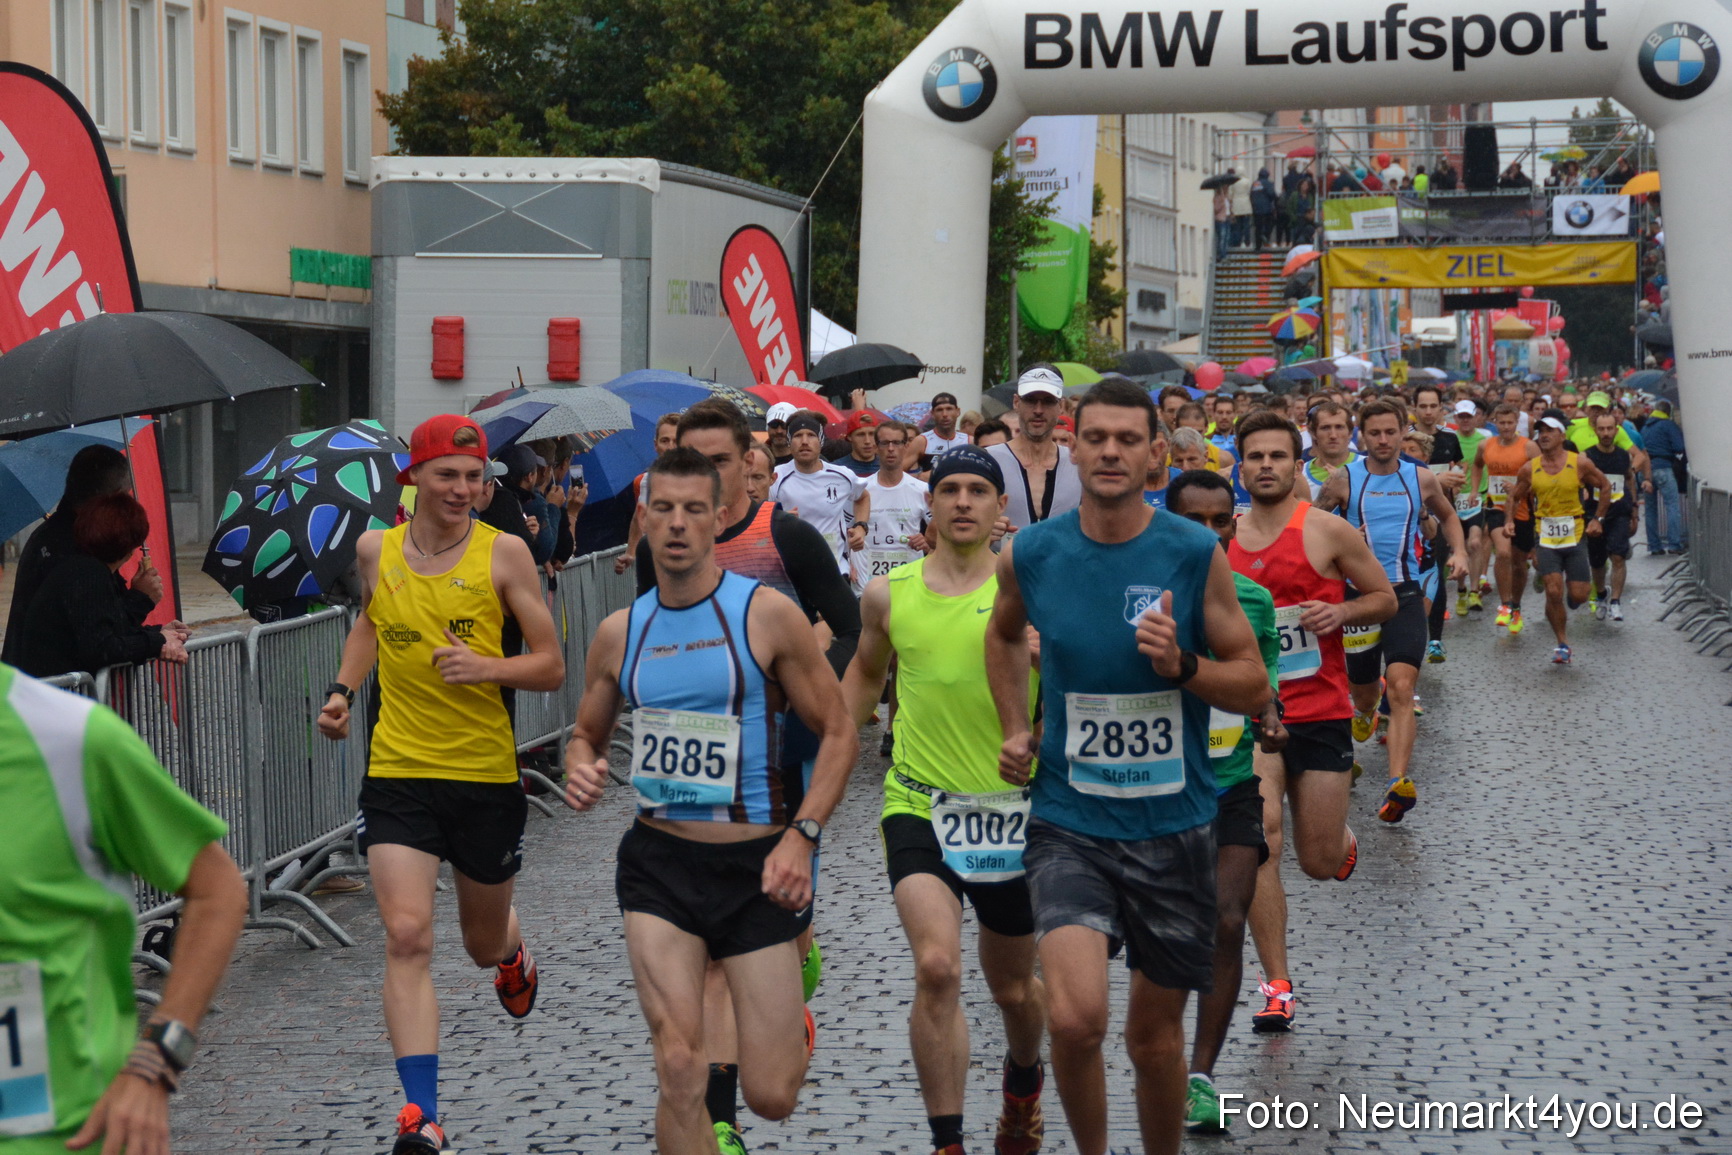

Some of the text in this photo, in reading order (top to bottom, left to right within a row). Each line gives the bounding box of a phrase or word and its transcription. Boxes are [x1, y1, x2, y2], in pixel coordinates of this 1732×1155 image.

[1024, 0, 1608, 71] BMW Laufsport
[1647, 23, 1714, 50] BMW
[928, 48, 989, 76] BMW
[1446, 253, 1515, 278] ZIEL
[1547, 524, 1569, 537] 319
[449, 618, 475, 634] MTP
[1276, 625, 1307, 652] 51
[1117, 694, 1172, 711] BOCK
[676, 713, 729, 733] BOCK
[1078, 716, 1174, 758] 2833
[641, 733, 727, 780] 2685
[1102, 768, 1150, 784] Stefan
[660, 783, 698, 804] Marco
[942, 811, 1026, 846] 2002
[966, 855, 1005, 869] Stefan
[0, 1006, 22, 1068] 1
